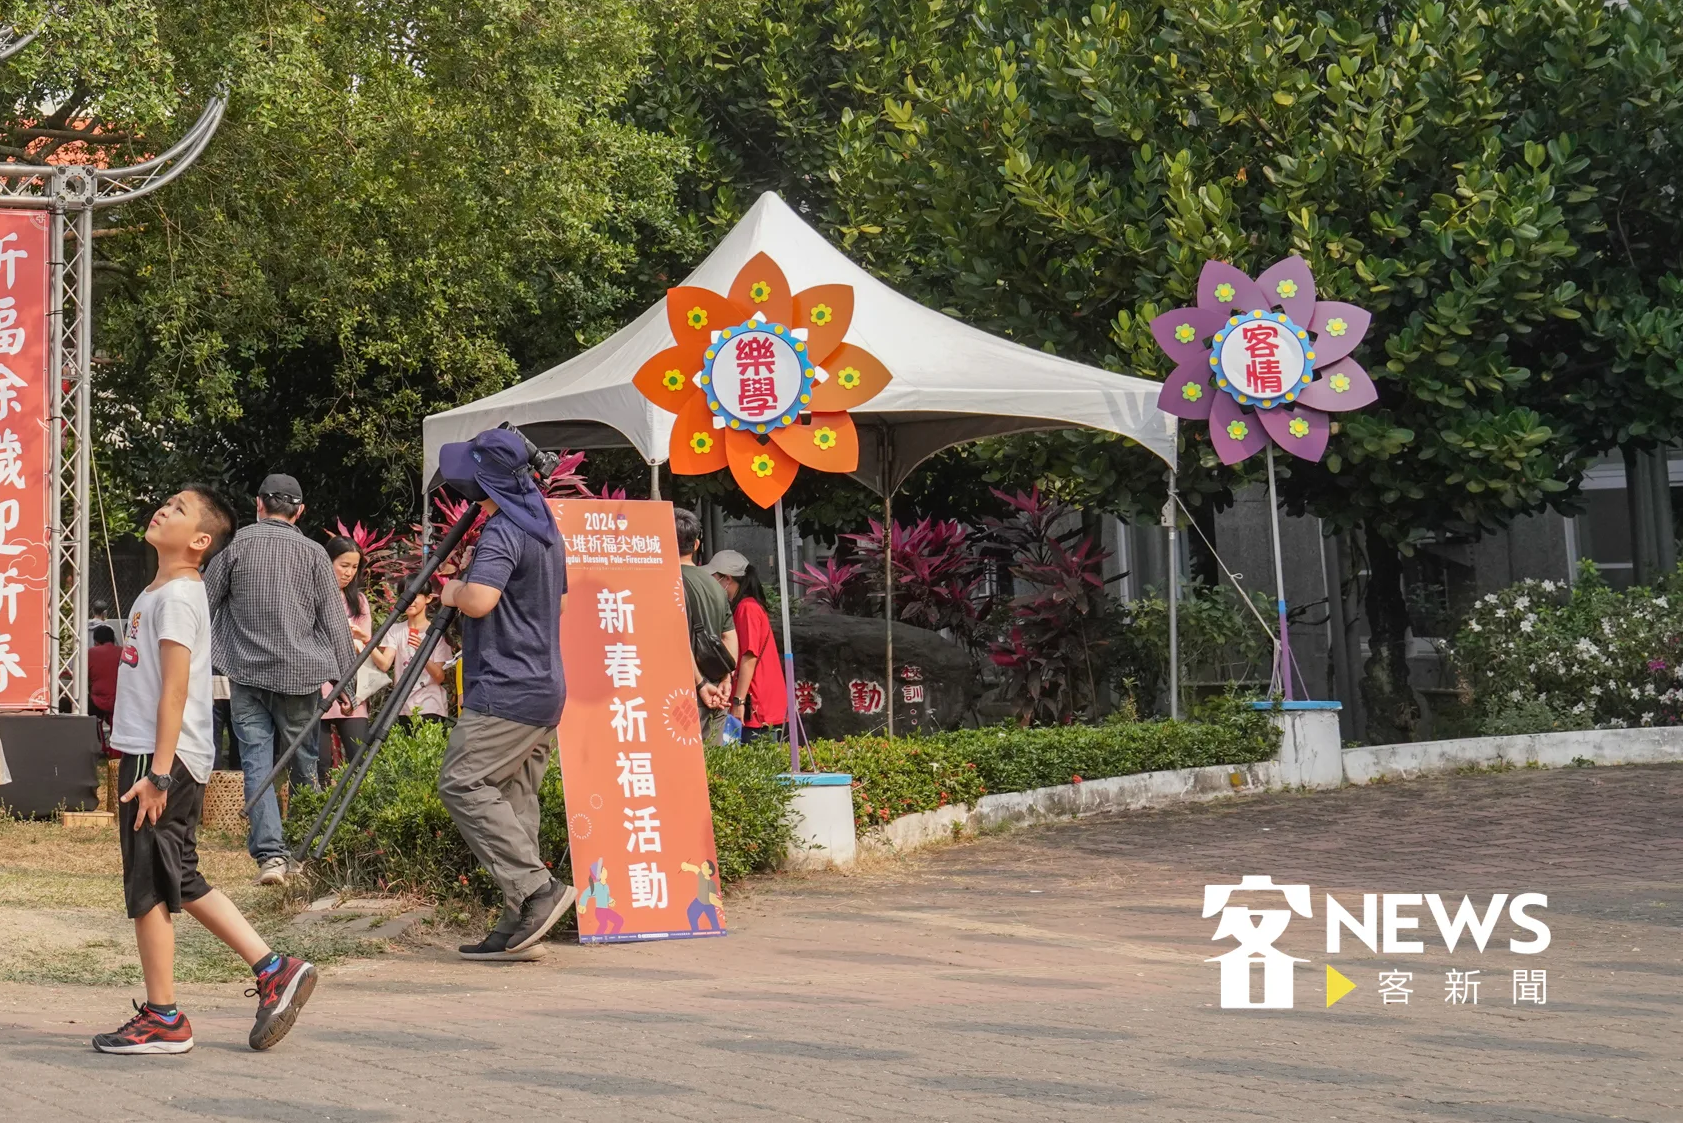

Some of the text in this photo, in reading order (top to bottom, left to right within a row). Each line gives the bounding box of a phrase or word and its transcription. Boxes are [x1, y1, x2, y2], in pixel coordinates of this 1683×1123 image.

[734, 337, 779, 417] 樂學
[1241, 324, 1287, 394] 客情
[584, 512, 616, 531] 2024
[583, 555, 608, 565] Blessing
[849, 679, 886, 714] 勤
[597, 588, 668, 909] 新春祈福活動
